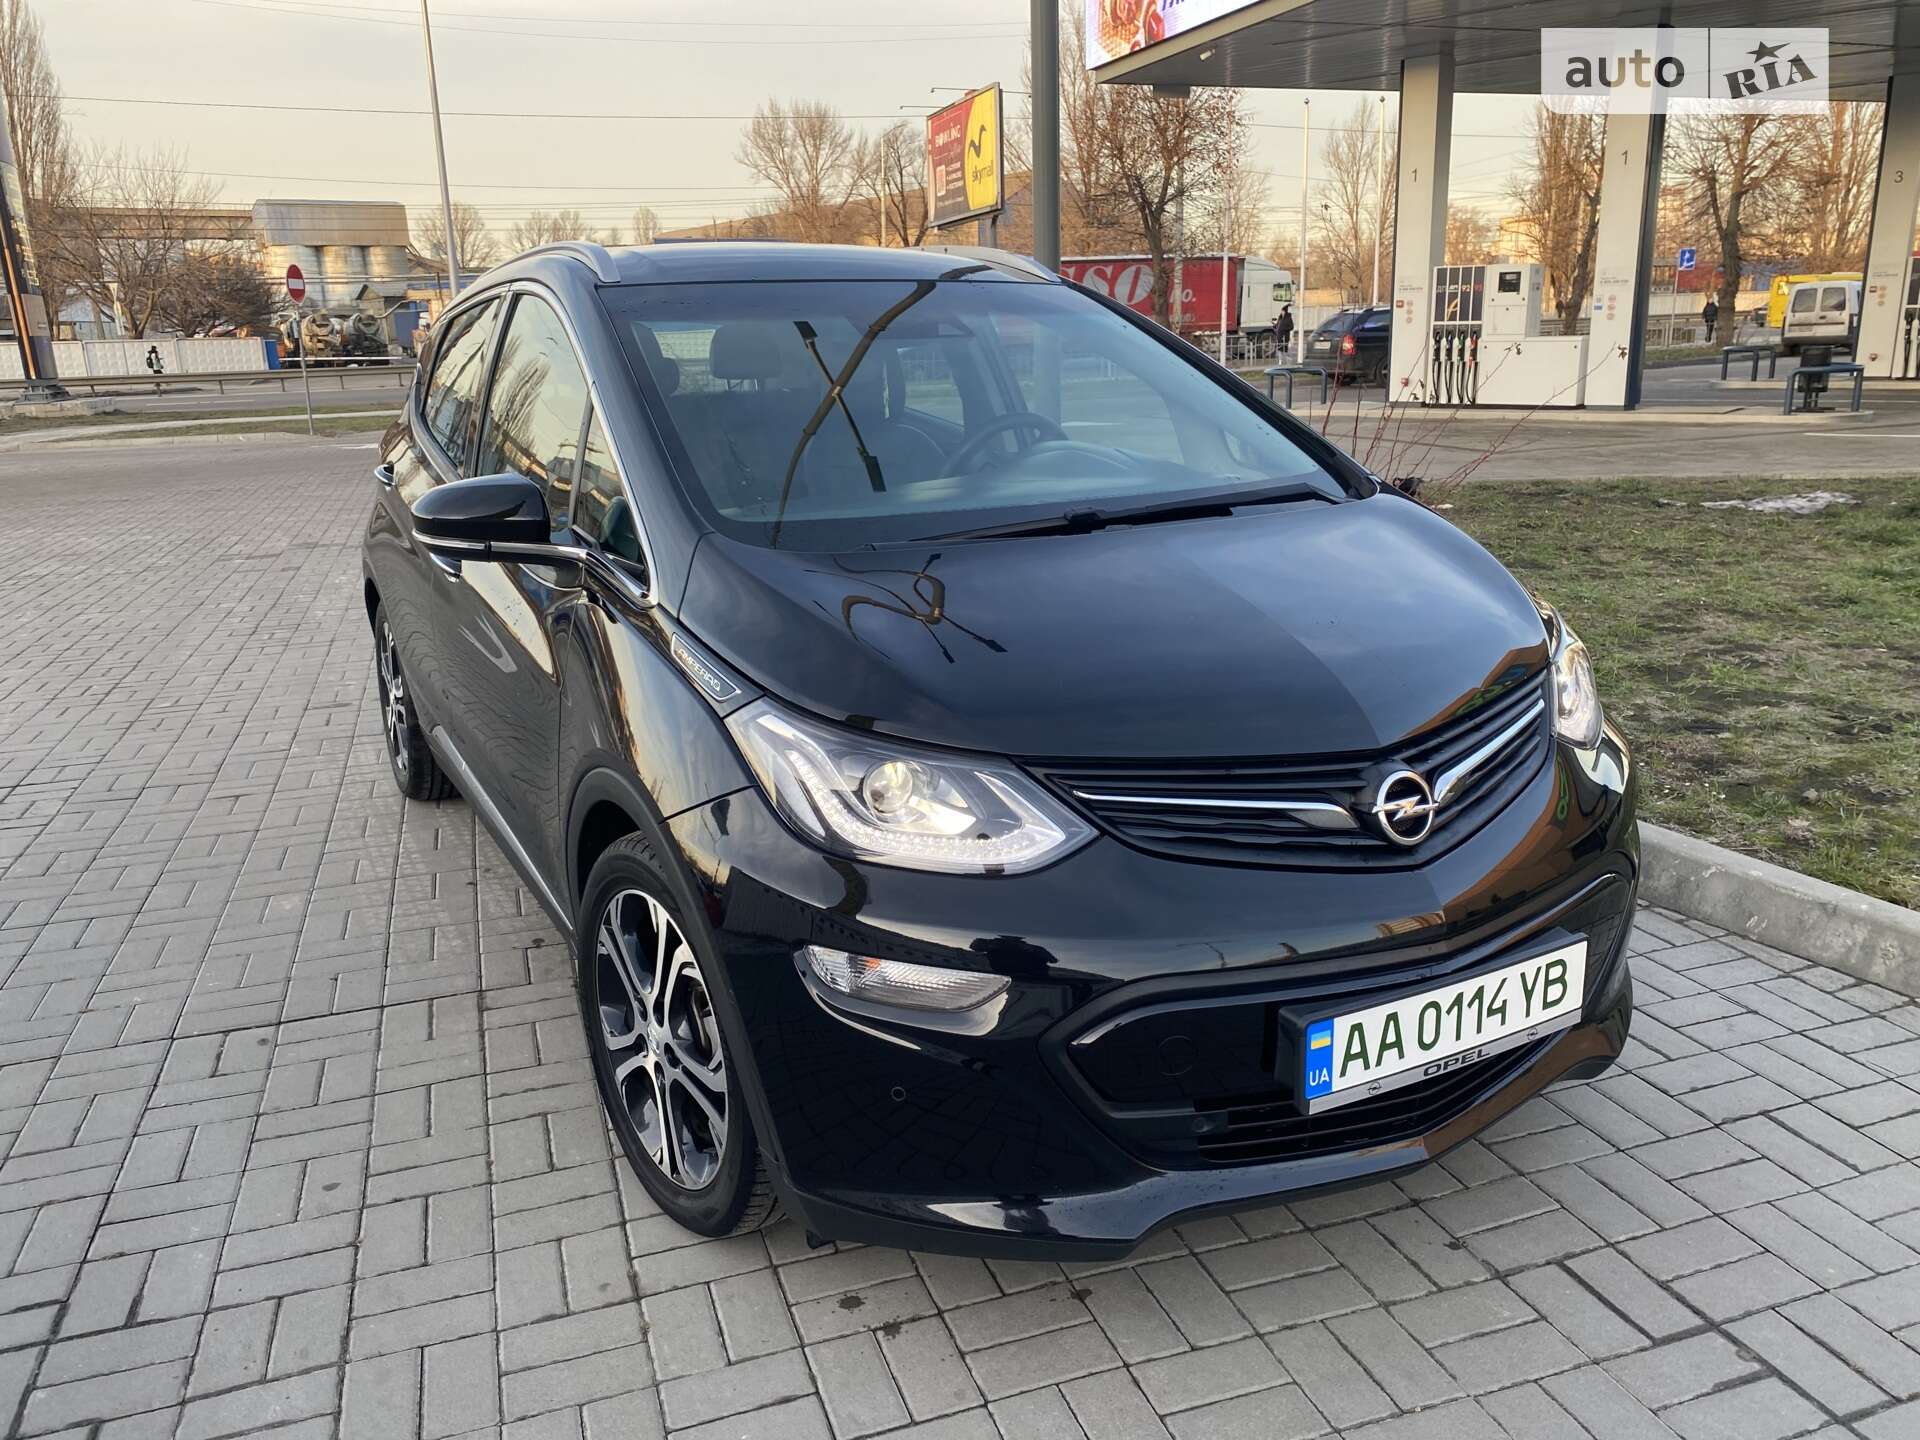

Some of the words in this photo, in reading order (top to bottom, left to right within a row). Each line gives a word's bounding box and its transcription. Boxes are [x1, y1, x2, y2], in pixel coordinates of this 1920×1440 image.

[1893, 170, 1904, 184] 3
[1339, 1011, 1404, 1078] AA
[1417, 977, 1508, 1052] 0114
[1519, 958, 1569, 1018] YB
[1423, 1047, 1490, 1078] OPEL
[1309, 1070, 1330, 1087] UA
